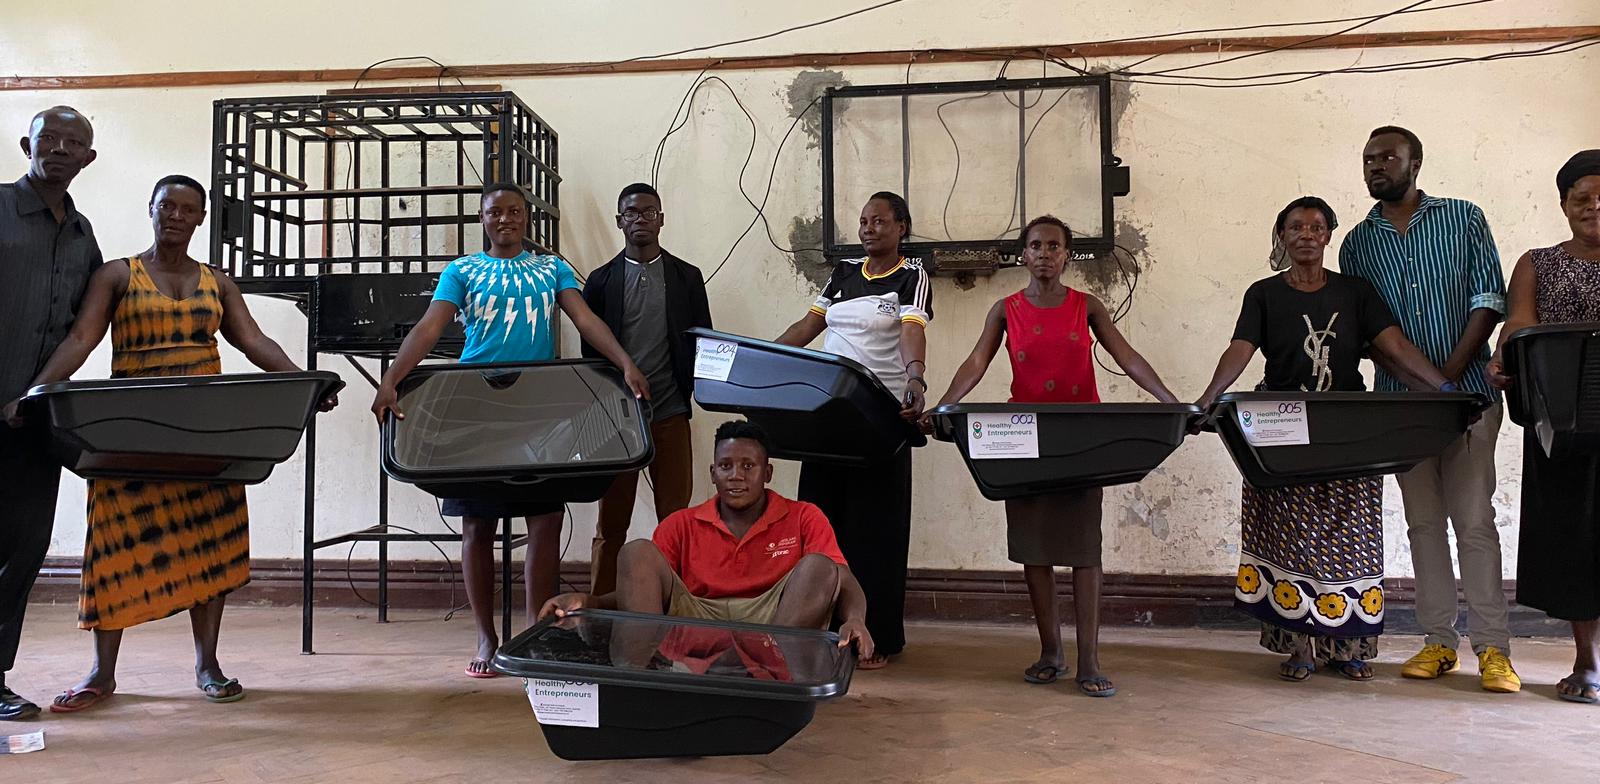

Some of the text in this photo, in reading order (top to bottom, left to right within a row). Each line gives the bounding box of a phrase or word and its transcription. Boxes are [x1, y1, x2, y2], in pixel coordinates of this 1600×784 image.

[717, 343, 737, 357] 004
[1278, 402, 1302, 414] 005
[1011, 414, 1035, 425] 002
[535, 679, 566, 689] Healthy
[535, 688, 592, 698] Entrepreneurs
